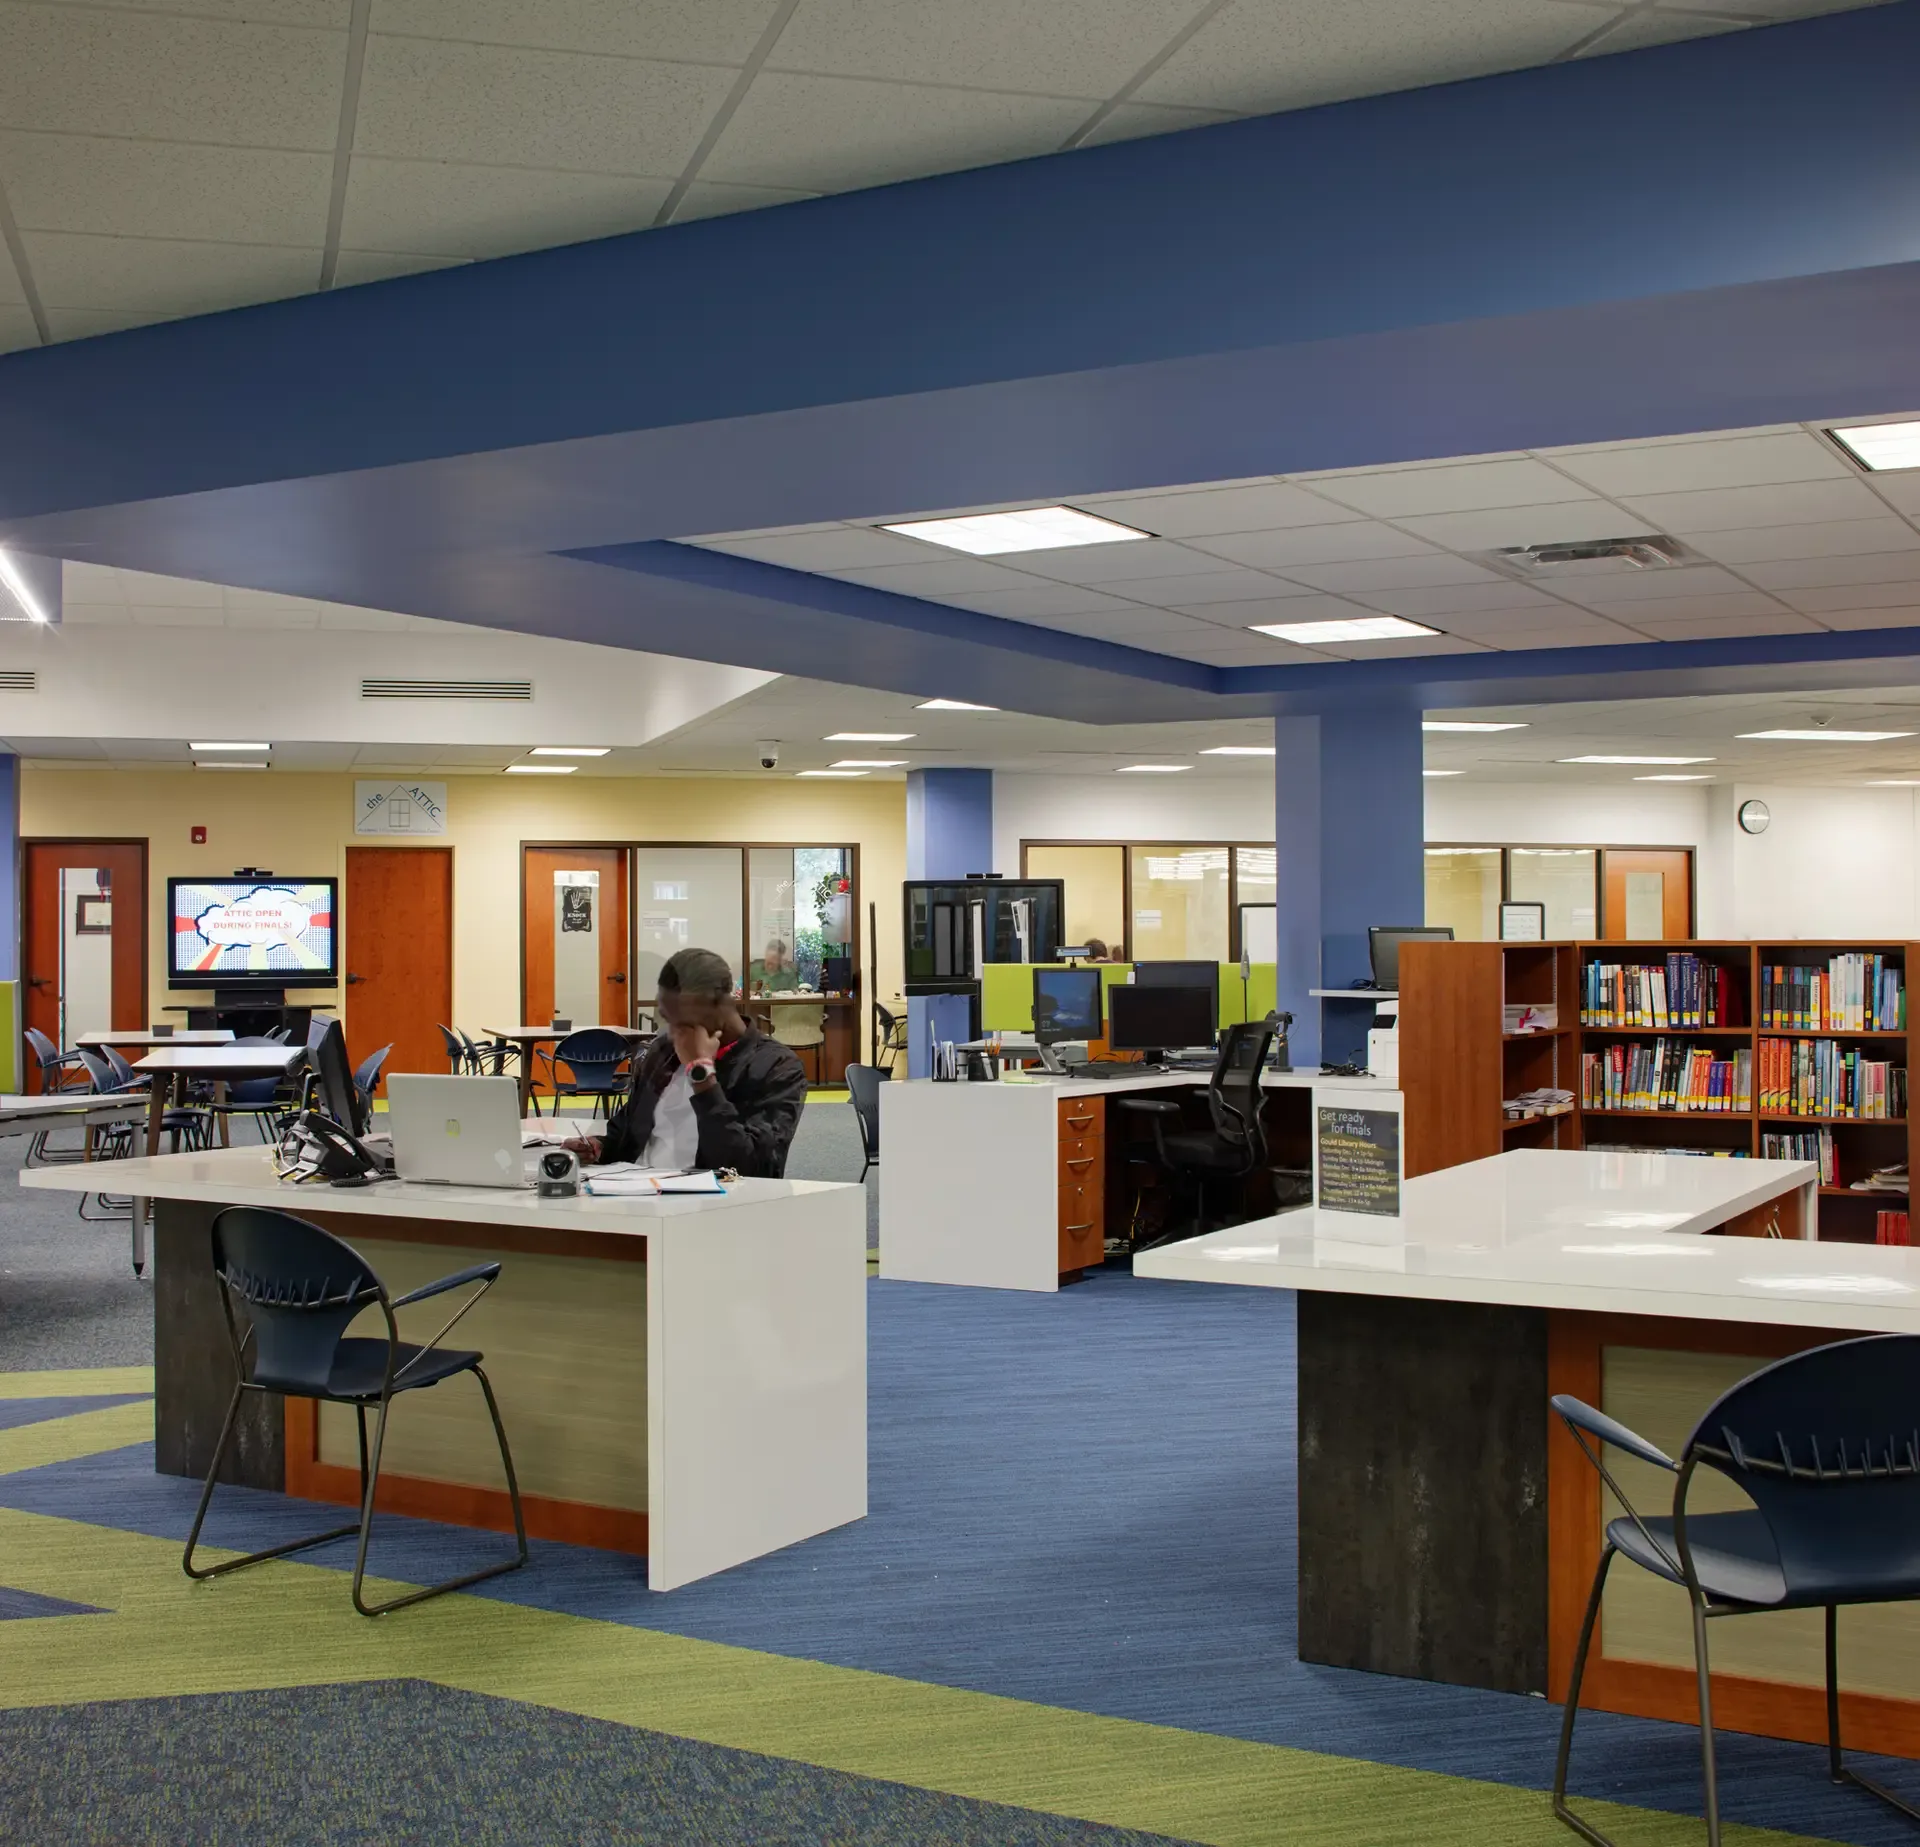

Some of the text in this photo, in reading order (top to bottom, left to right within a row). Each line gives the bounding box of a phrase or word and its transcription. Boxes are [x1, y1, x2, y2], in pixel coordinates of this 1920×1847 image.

[366, 787, 441, 817] the ATTIC
[1320, 1110, 1364, 1125] Get ready
[1331, 1122, 1371, 1136] for finals
[1339, 1139, 1358, 1148] Library
[1359, 1140, 1376, 1148] Hours
